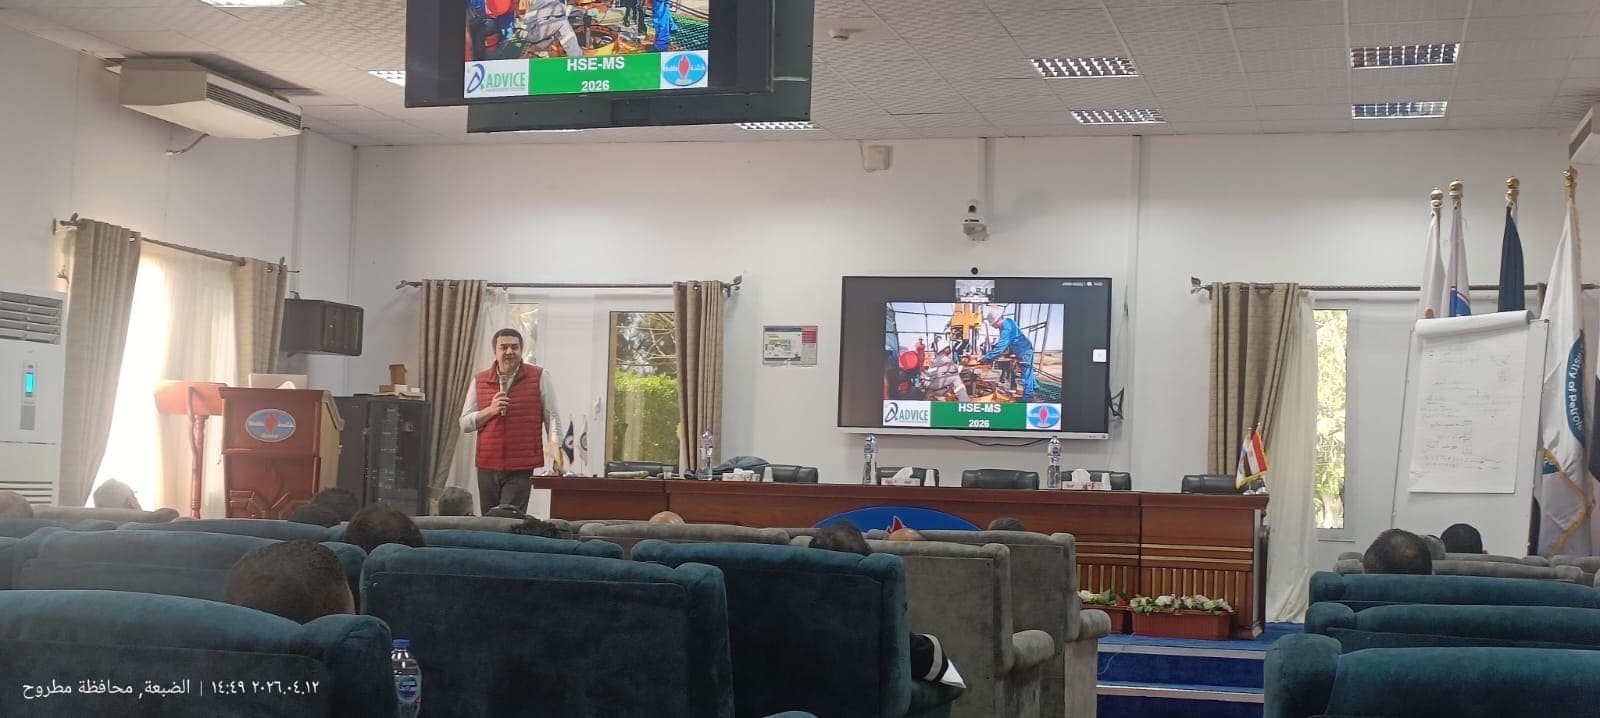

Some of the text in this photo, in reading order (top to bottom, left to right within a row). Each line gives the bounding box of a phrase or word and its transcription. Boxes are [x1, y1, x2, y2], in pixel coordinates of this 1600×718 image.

[567, 56, 625, 71] HSE-MS
[486, 71, 526, 88] ADVICE
[581, 80, 610, 92] 2026
[1568, 381, 1577, 392] of
[958, 402, 1001, 413] HSE-MS
[899, 408, 929, 421] ADVICE
[968, 419, 990, 428] 2026
